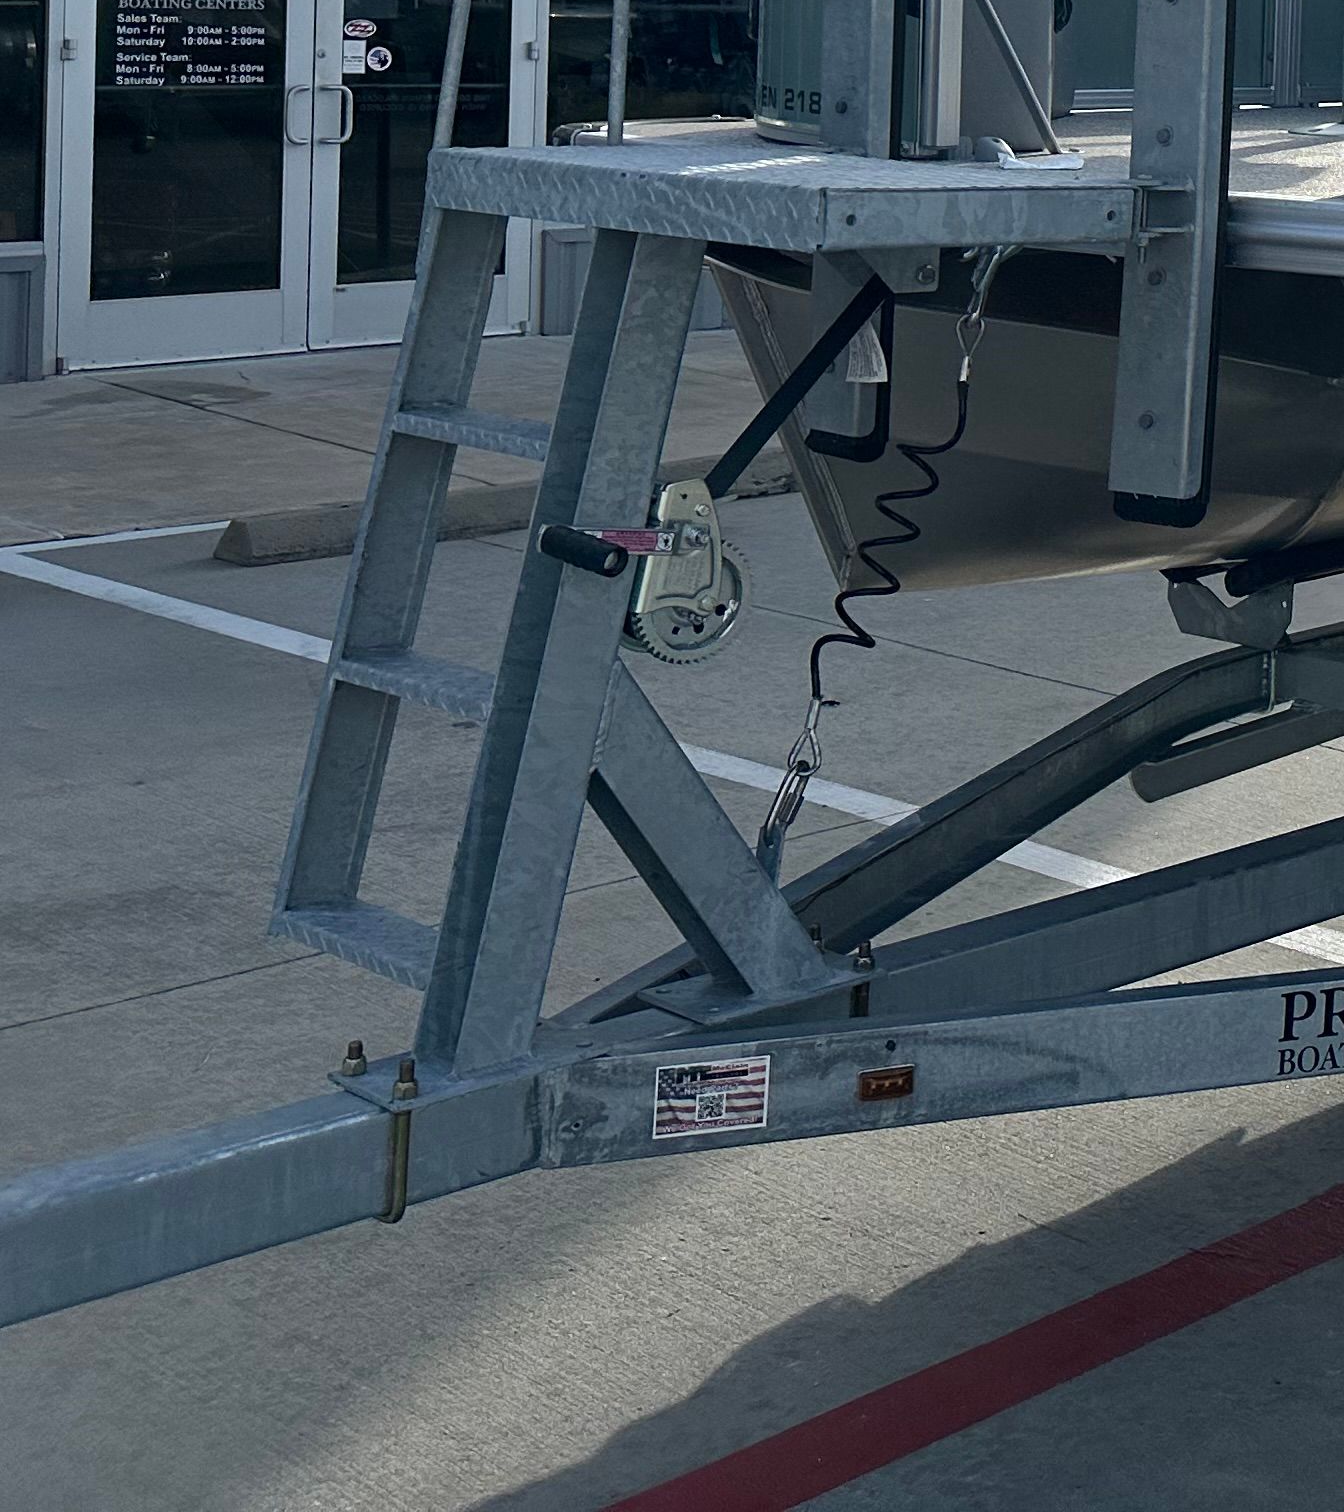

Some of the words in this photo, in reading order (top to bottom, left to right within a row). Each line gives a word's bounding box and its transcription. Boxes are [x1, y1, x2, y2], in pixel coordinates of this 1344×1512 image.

[116, 13, 147, 23] Sales
[150, 14, 182, 23] Team:
[116, 25, 141, 35] Mon
[150, 25, 165, 34] Fri
[187, 26, 222, 35] 9:00AM
[231, 26, 265, 35] 5:00PM
[116, 37, 166, 48] Saturday
[231, 37, 265, 45] 2:00PM
[116, 53, 157, 62] Service
[160, 53, 192, 62] Team:
[116, 65, 140, 73] Mon
[149, 64, 164, 73] Fri
[116, 76, 165, 86] Saturday
[784, 88, 822, 115] 218
